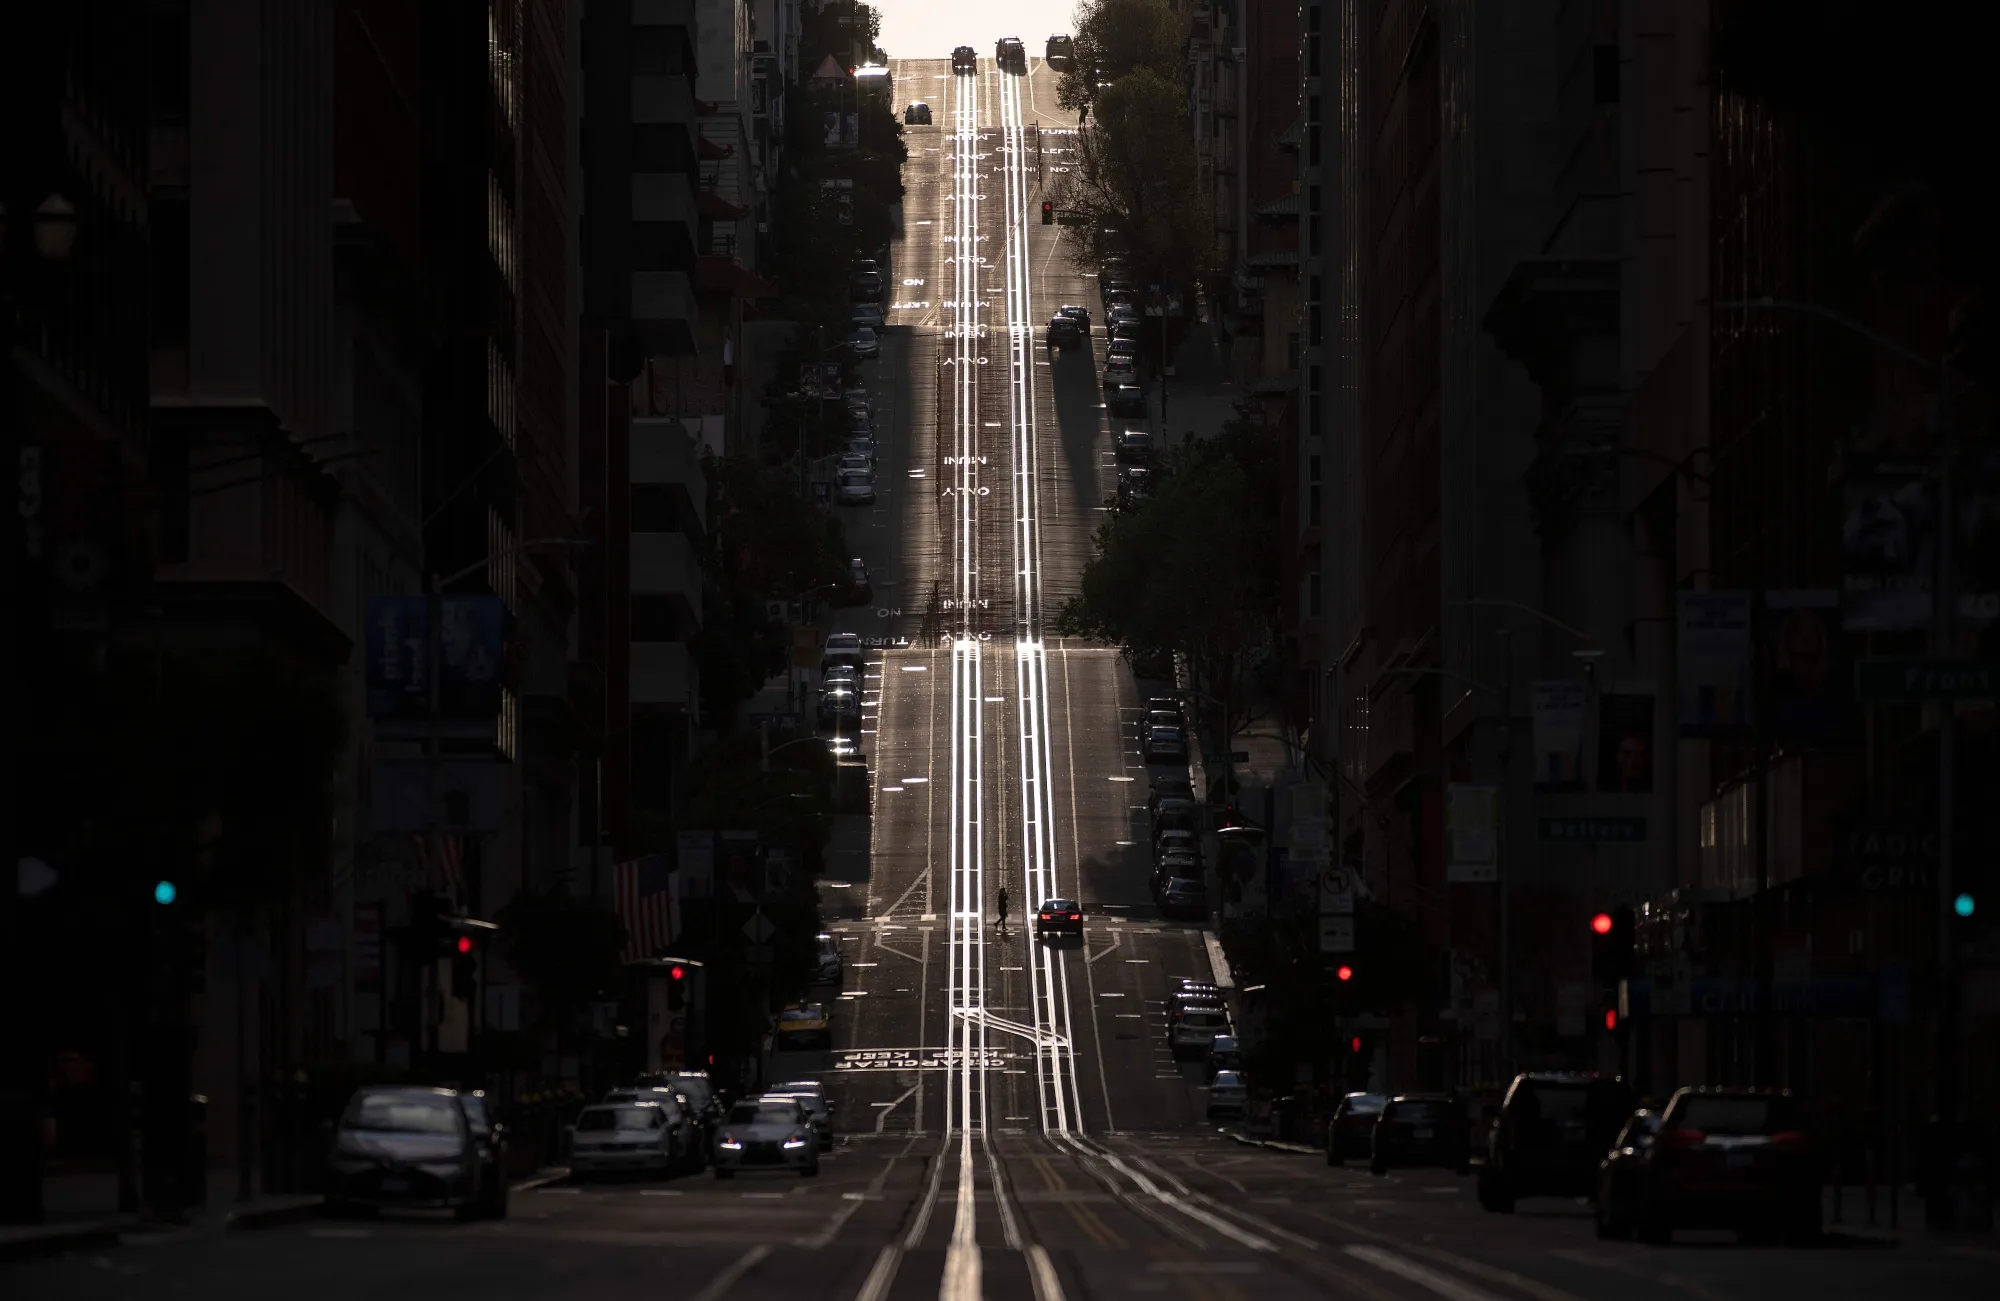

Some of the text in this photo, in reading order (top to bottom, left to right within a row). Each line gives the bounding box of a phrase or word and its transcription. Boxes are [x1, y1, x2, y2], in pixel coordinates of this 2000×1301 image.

[892, 301, 930, 309] LEFT
[943, 456, 987, 464] MUNI
[941, 486, 990, 496] ONLY
[943, 599, 989, 608] MUNI
[877, 608, 902, 618] NO
[859, 636, 909, 646] TURN
[1905, 665, 1989, 691] Front
[1848, 831, 1941, 857] TADIC
[844, 1051, 910, 1060] KEEP
[834, 1059, 918, 1069] CLEAR
